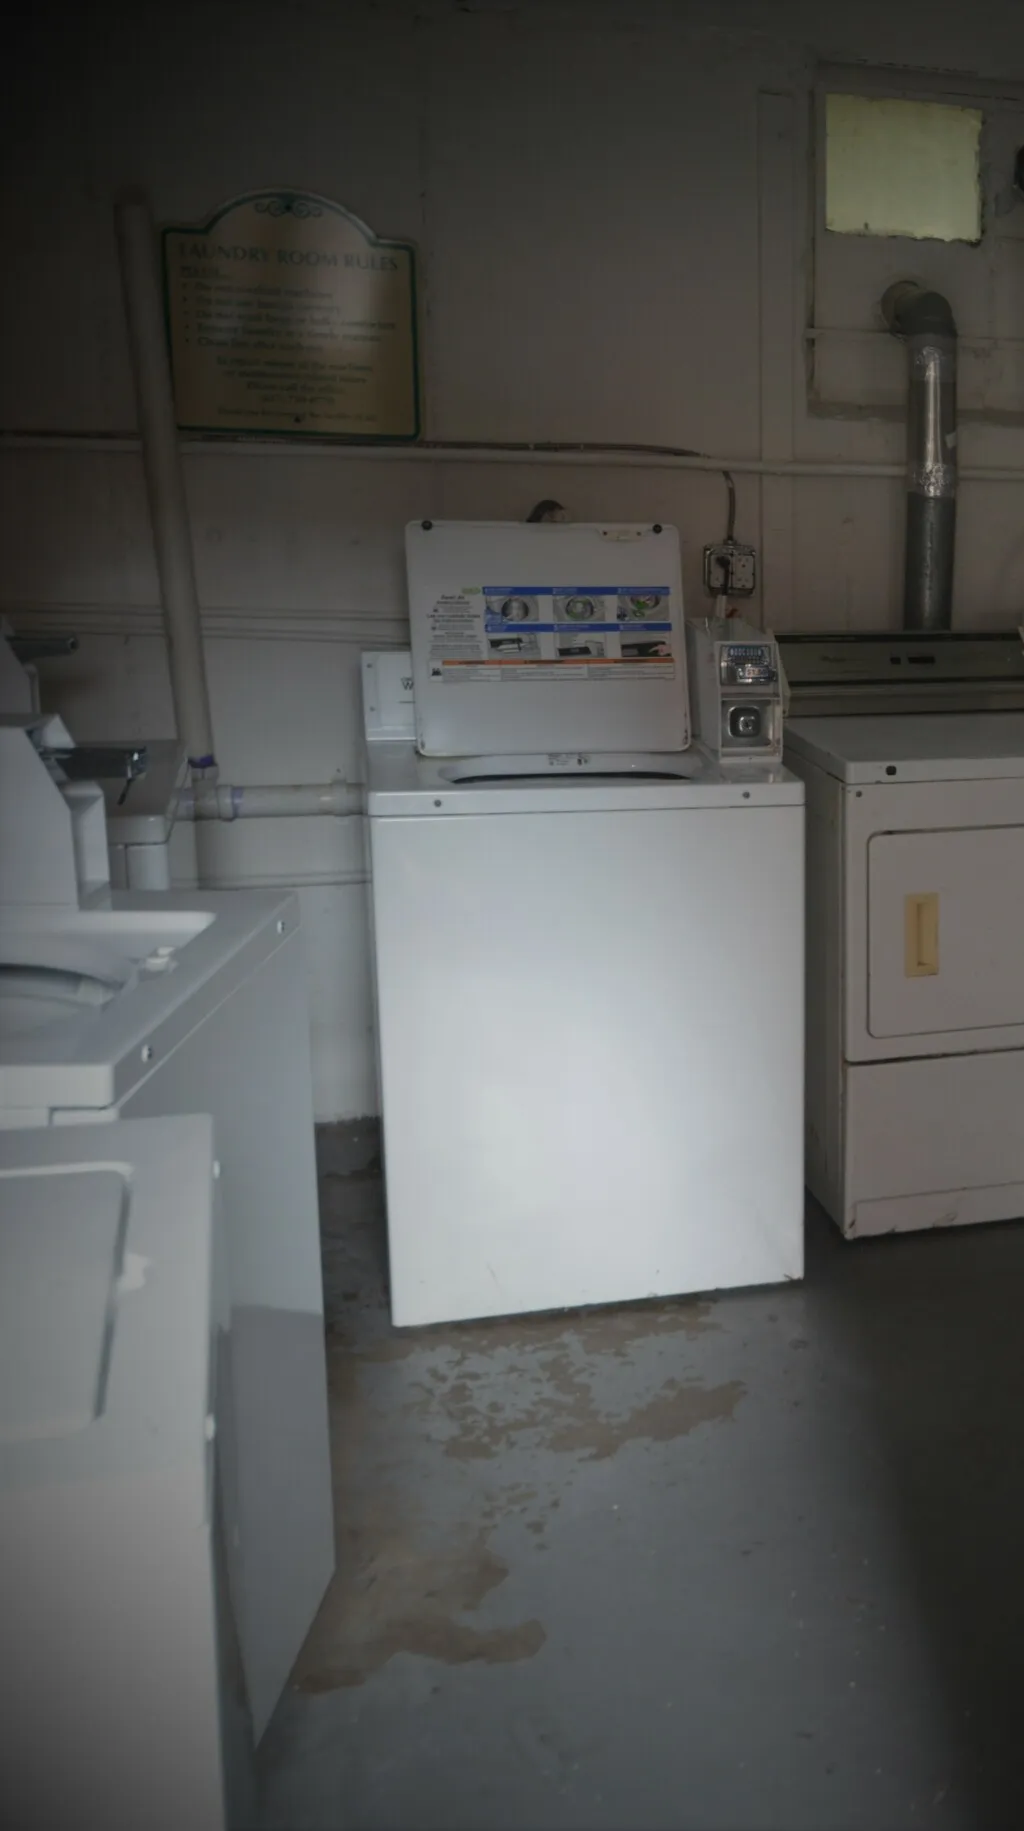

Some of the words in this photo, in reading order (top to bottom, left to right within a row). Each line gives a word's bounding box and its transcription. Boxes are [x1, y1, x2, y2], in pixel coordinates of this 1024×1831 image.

[178, 242, 268, 263] LAUNDRY
[277, 248, 338, 267] ROOM
[344, 253, 399, 271] RULES
